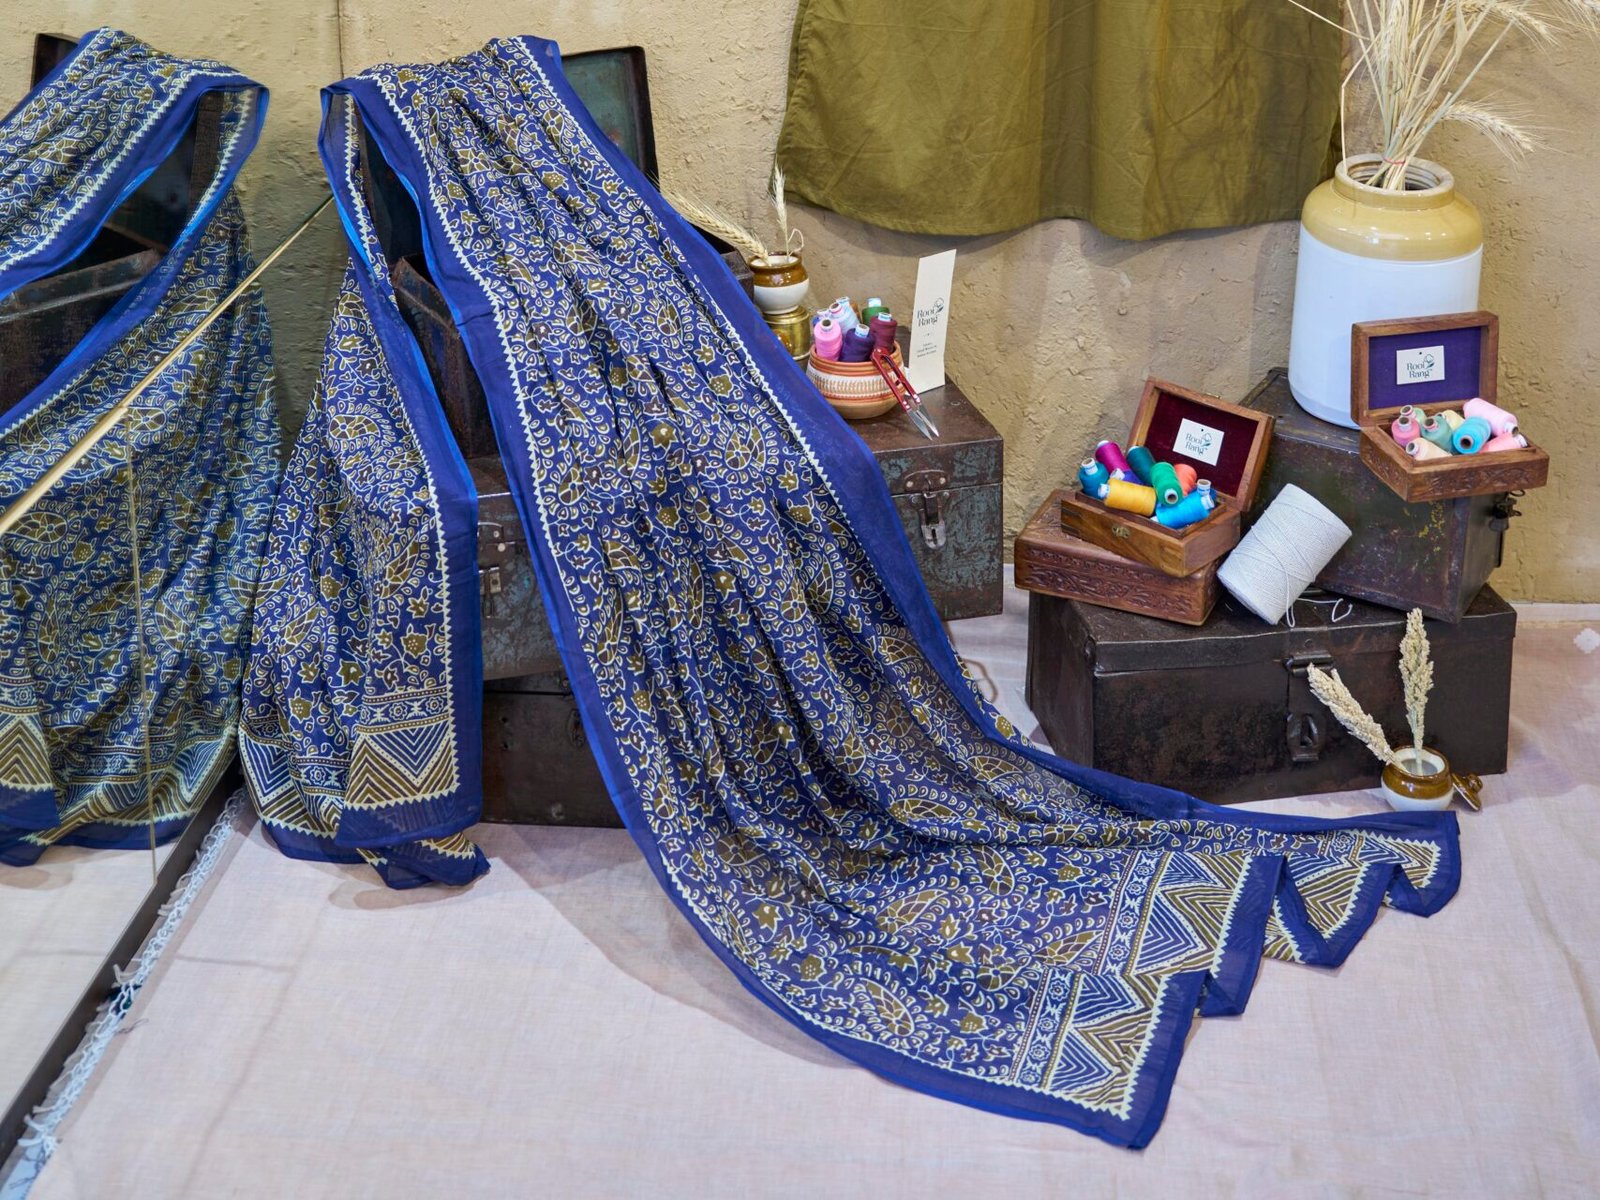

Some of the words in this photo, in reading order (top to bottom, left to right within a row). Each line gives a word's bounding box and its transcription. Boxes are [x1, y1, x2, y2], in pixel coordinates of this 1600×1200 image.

[1406, 361, 1425, 371] Rooi
[1409, 370, 1430, 379] Rang
[1185, 433, 1203, 445] Rooi
[1185, 441, 1205, 456] Rang
